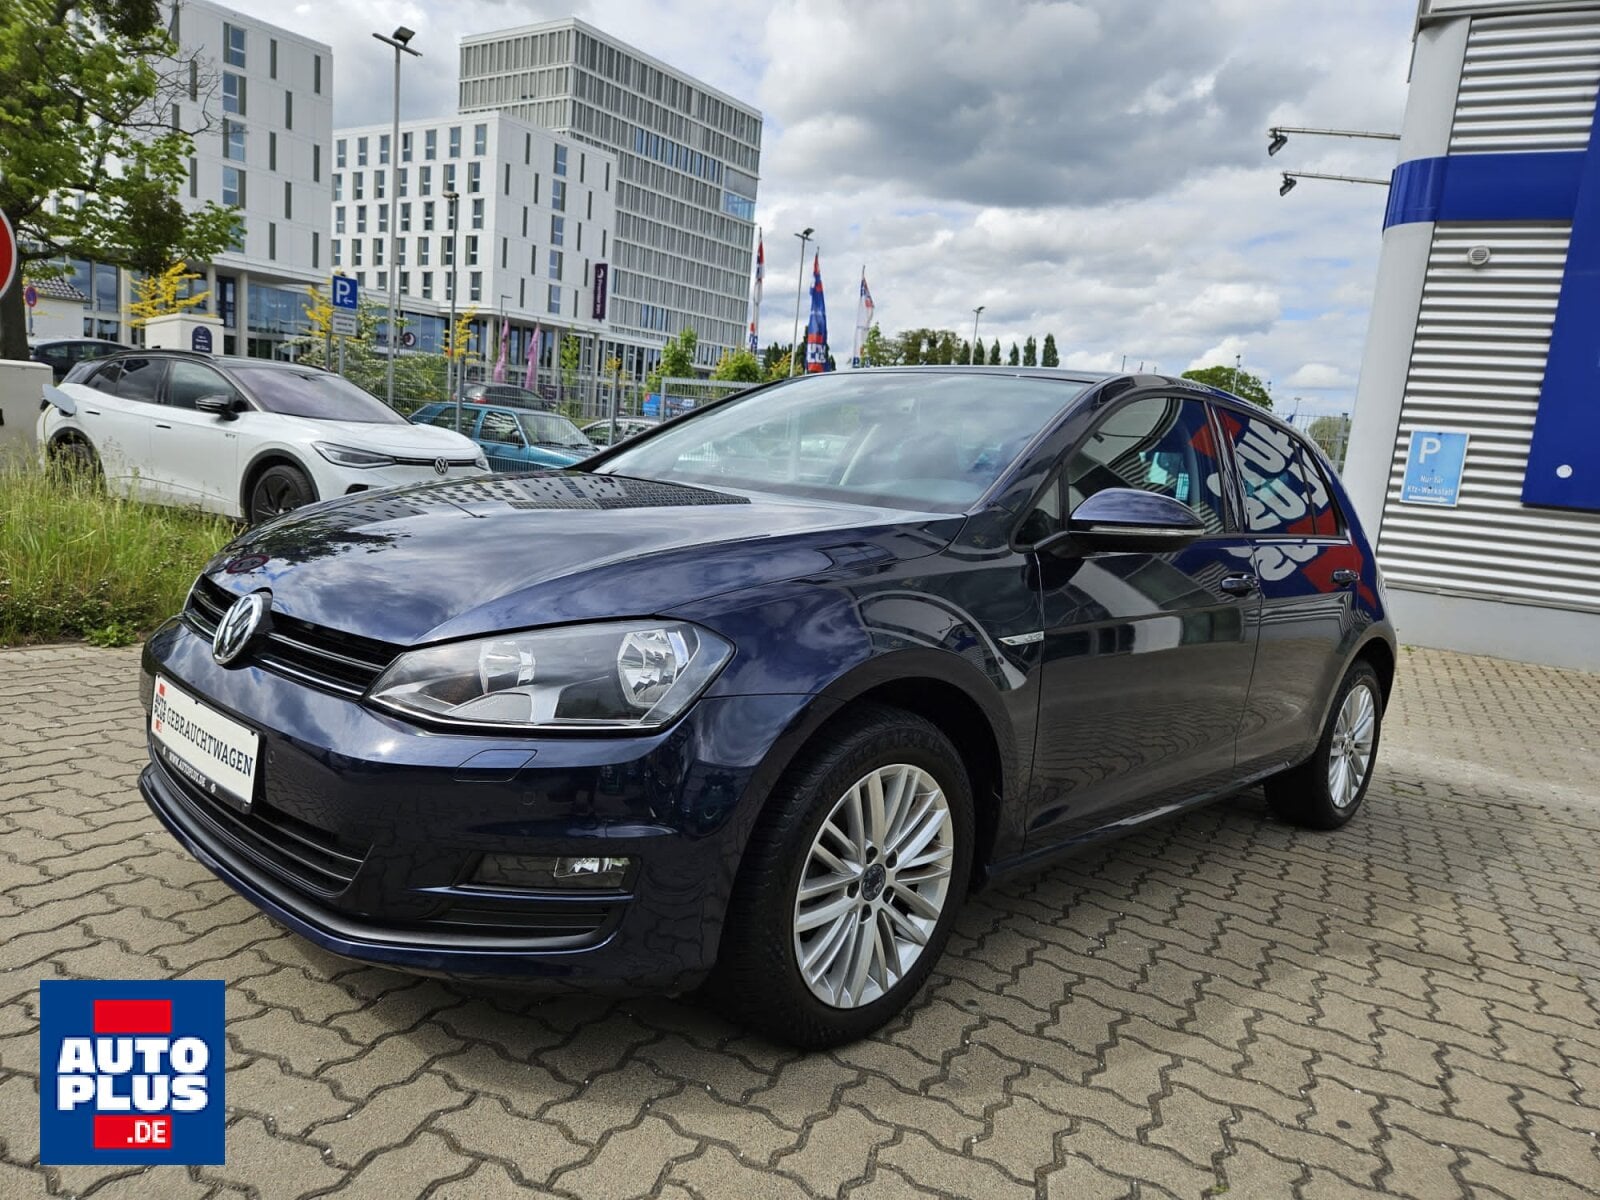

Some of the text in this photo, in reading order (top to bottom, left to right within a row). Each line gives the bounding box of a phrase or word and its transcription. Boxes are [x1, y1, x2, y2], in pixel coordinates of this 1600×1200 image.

[336, 280, 350, 304] P
[1419, 437, 1441, 464] P
[166, 707, 254, 778] GEBRAUCHTWAGEN
